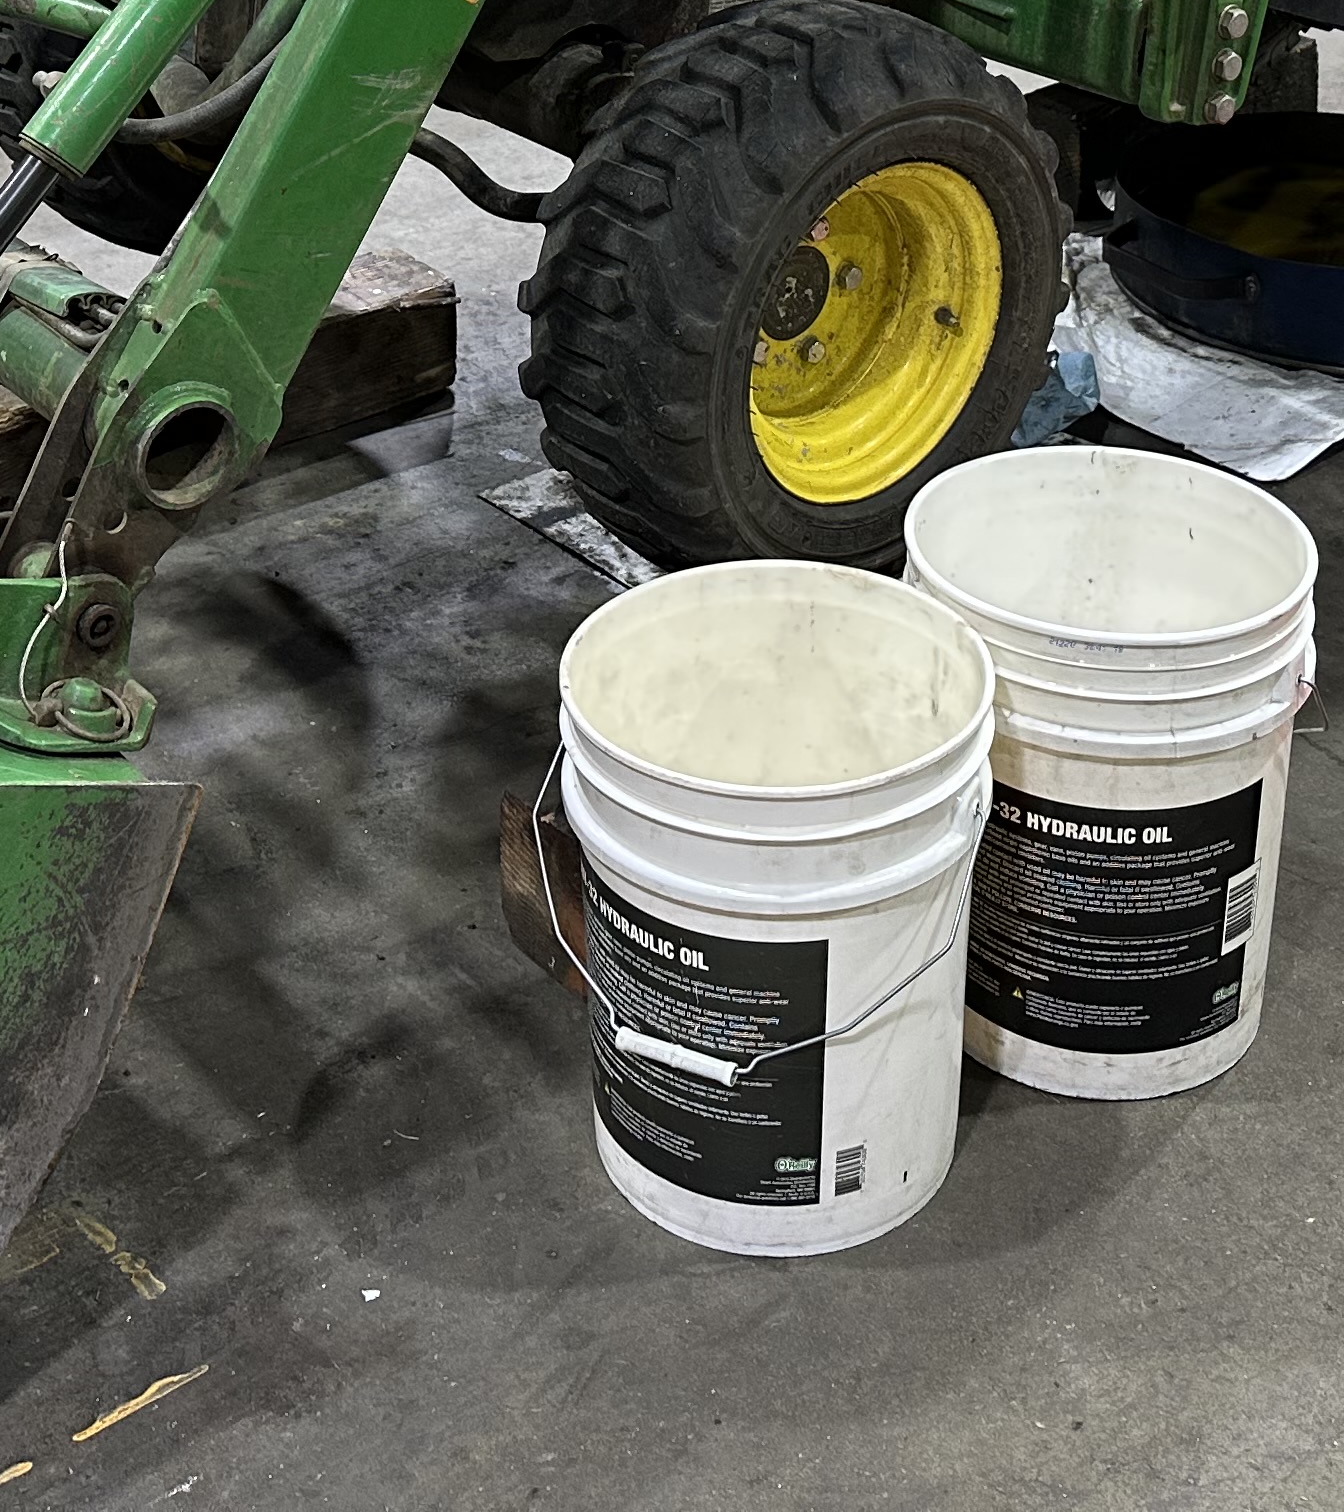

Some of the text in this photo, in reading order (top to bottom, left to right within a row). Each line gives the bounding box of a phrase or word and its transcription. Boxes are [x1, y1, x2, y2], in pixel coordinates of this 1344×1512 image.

[1026, 810, 1137, 845] HYDRAULIC
[1141, 825, 1174, 844] OIL
[599, 895, 675, 961] HYDRAULIC
[679, 946, 710, 972] OIL
